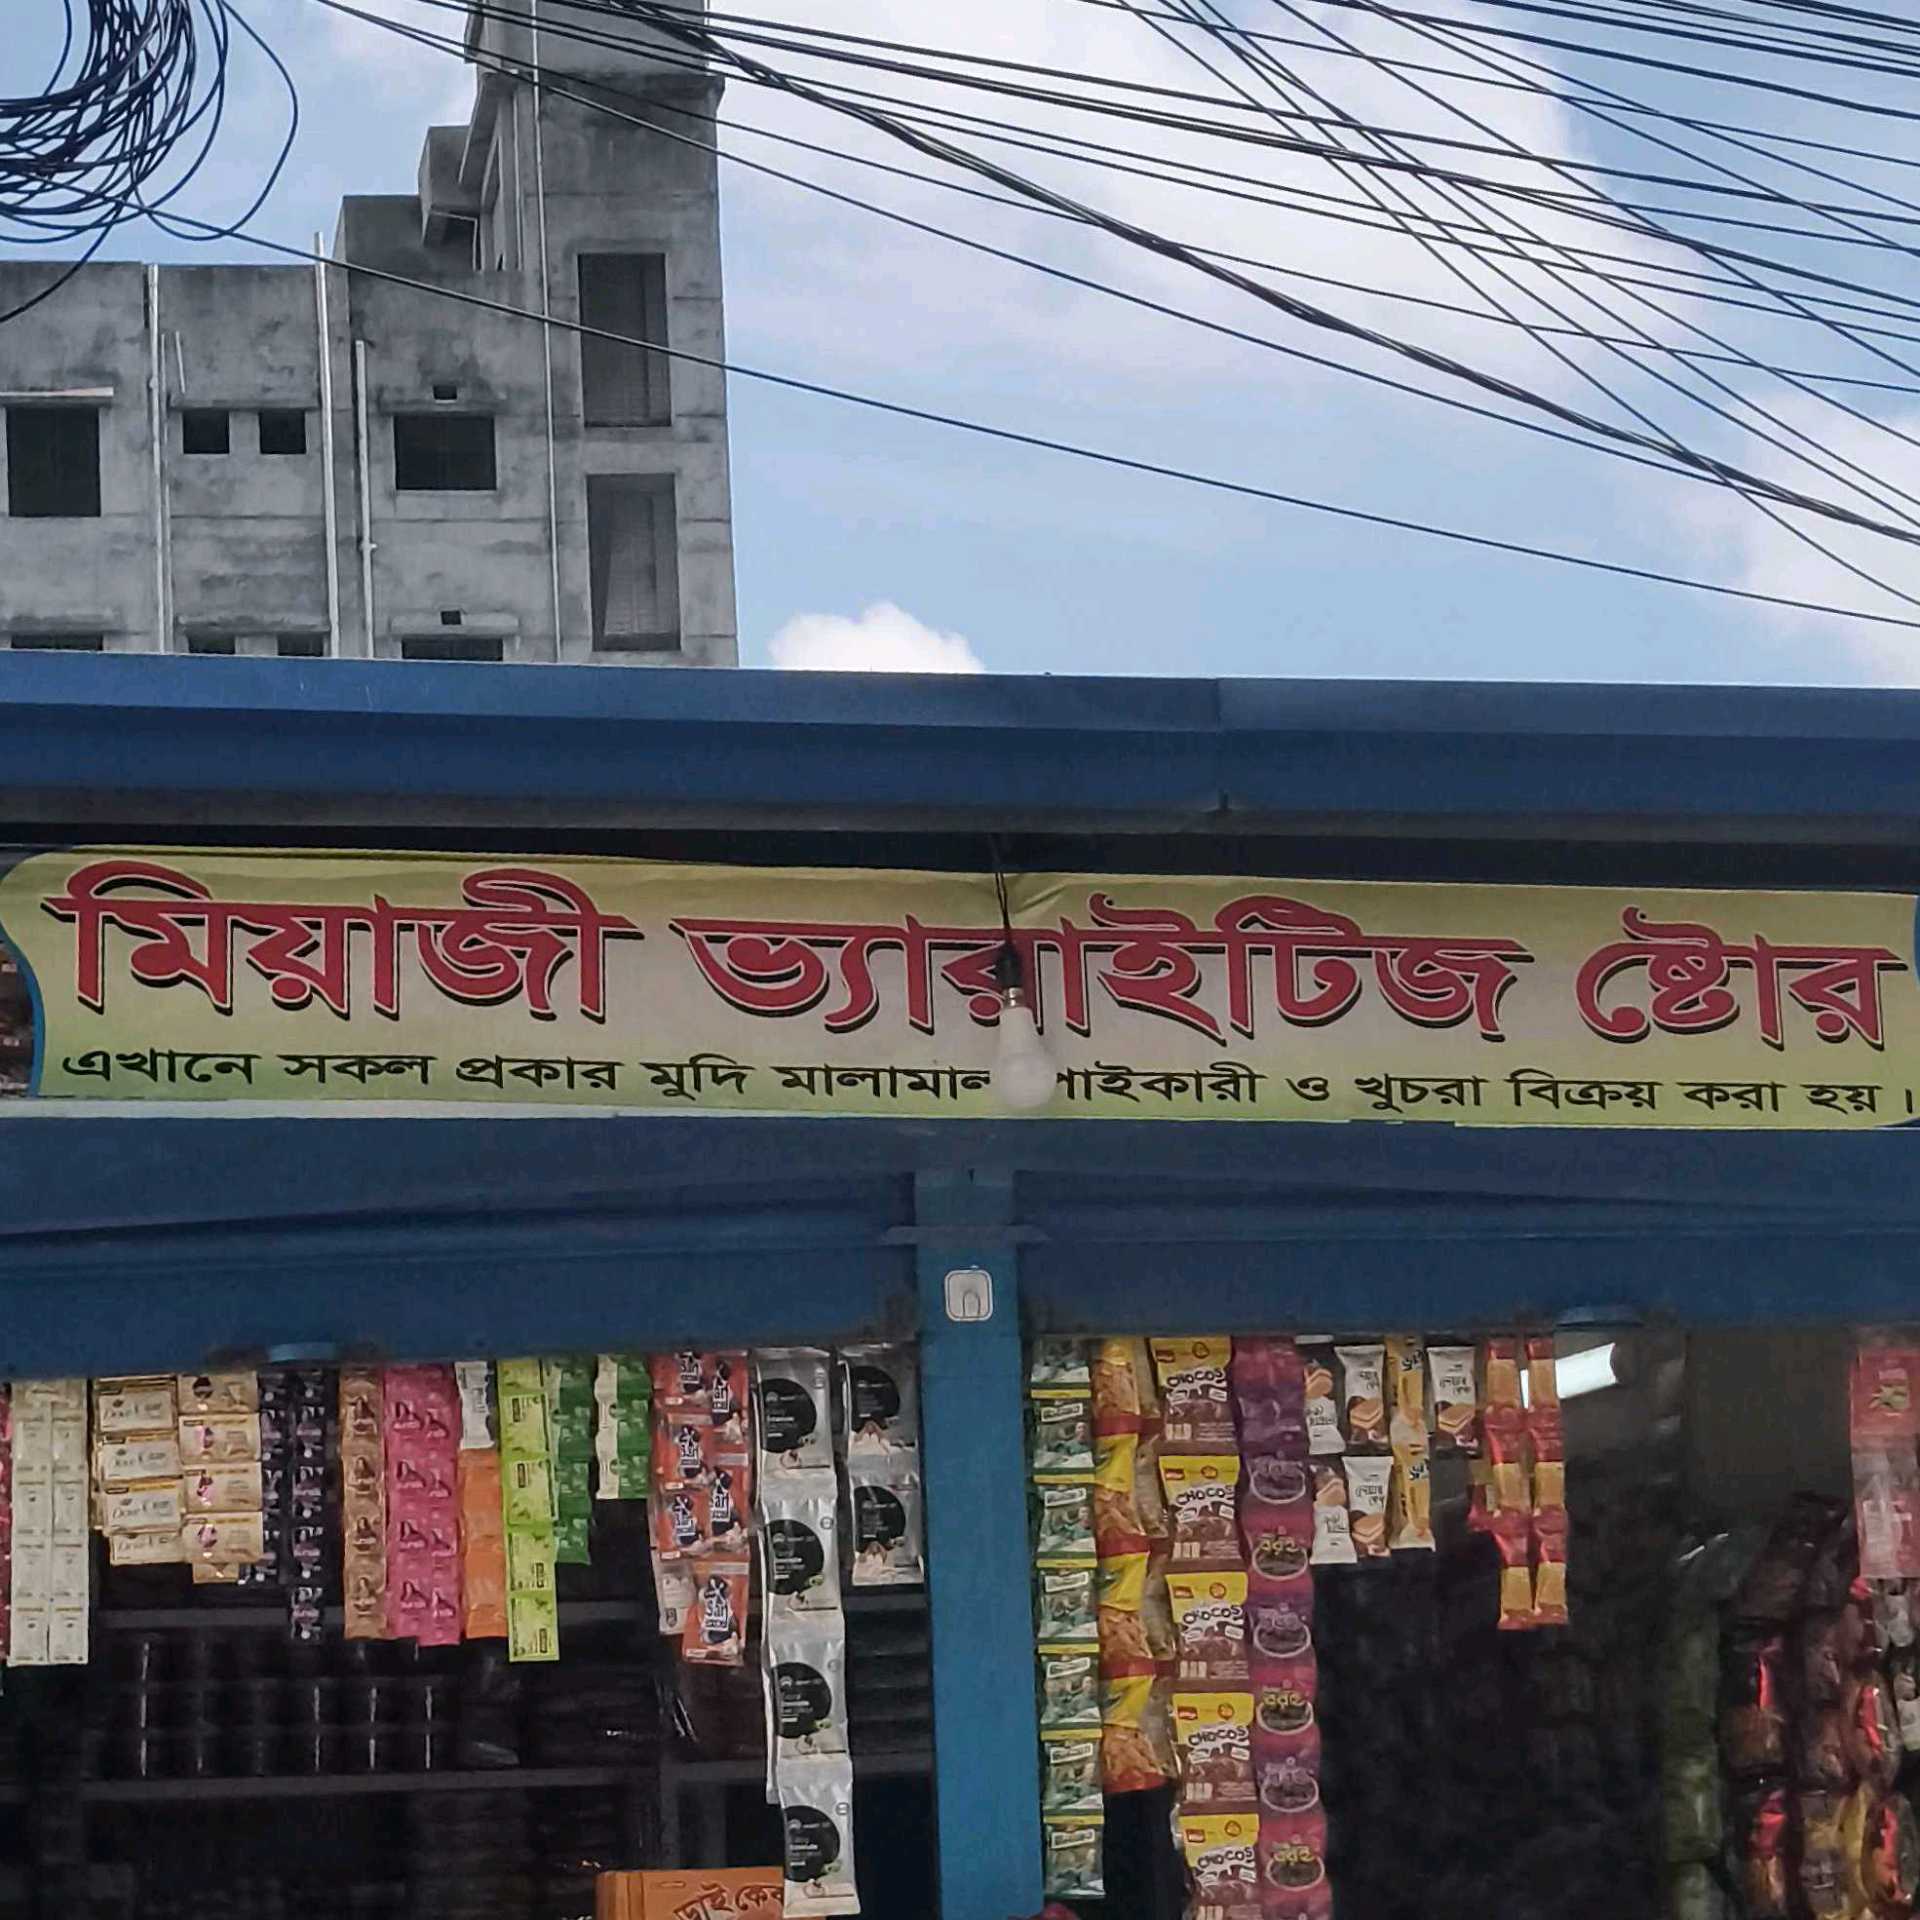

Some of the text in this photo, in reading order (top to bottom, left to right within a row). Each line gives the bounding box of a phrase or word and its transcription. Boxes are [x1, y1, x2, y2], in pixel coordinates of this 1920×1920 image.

[41, 860, 644, 1024] মিয়াজী
[670, 893, 1534, 1046] ভ্যারাইটিজ
[62, 1048, 262, 1085] এখানে
[276, 1055, 439, 1085] সকল
[455, 1054, 625, 1091] প্রকার
[639, 1052, 756, 1102] মুদি
[1285, 1076, 1330, 1102] ও
[1354, 1073, 1489, 1114] খুচরা
[1505, 1068, 1664, 1110] বিক্রয়
[1676, 1081, 1787, 1113] করা
[1800, 1084, 1884, 1115] হয়
